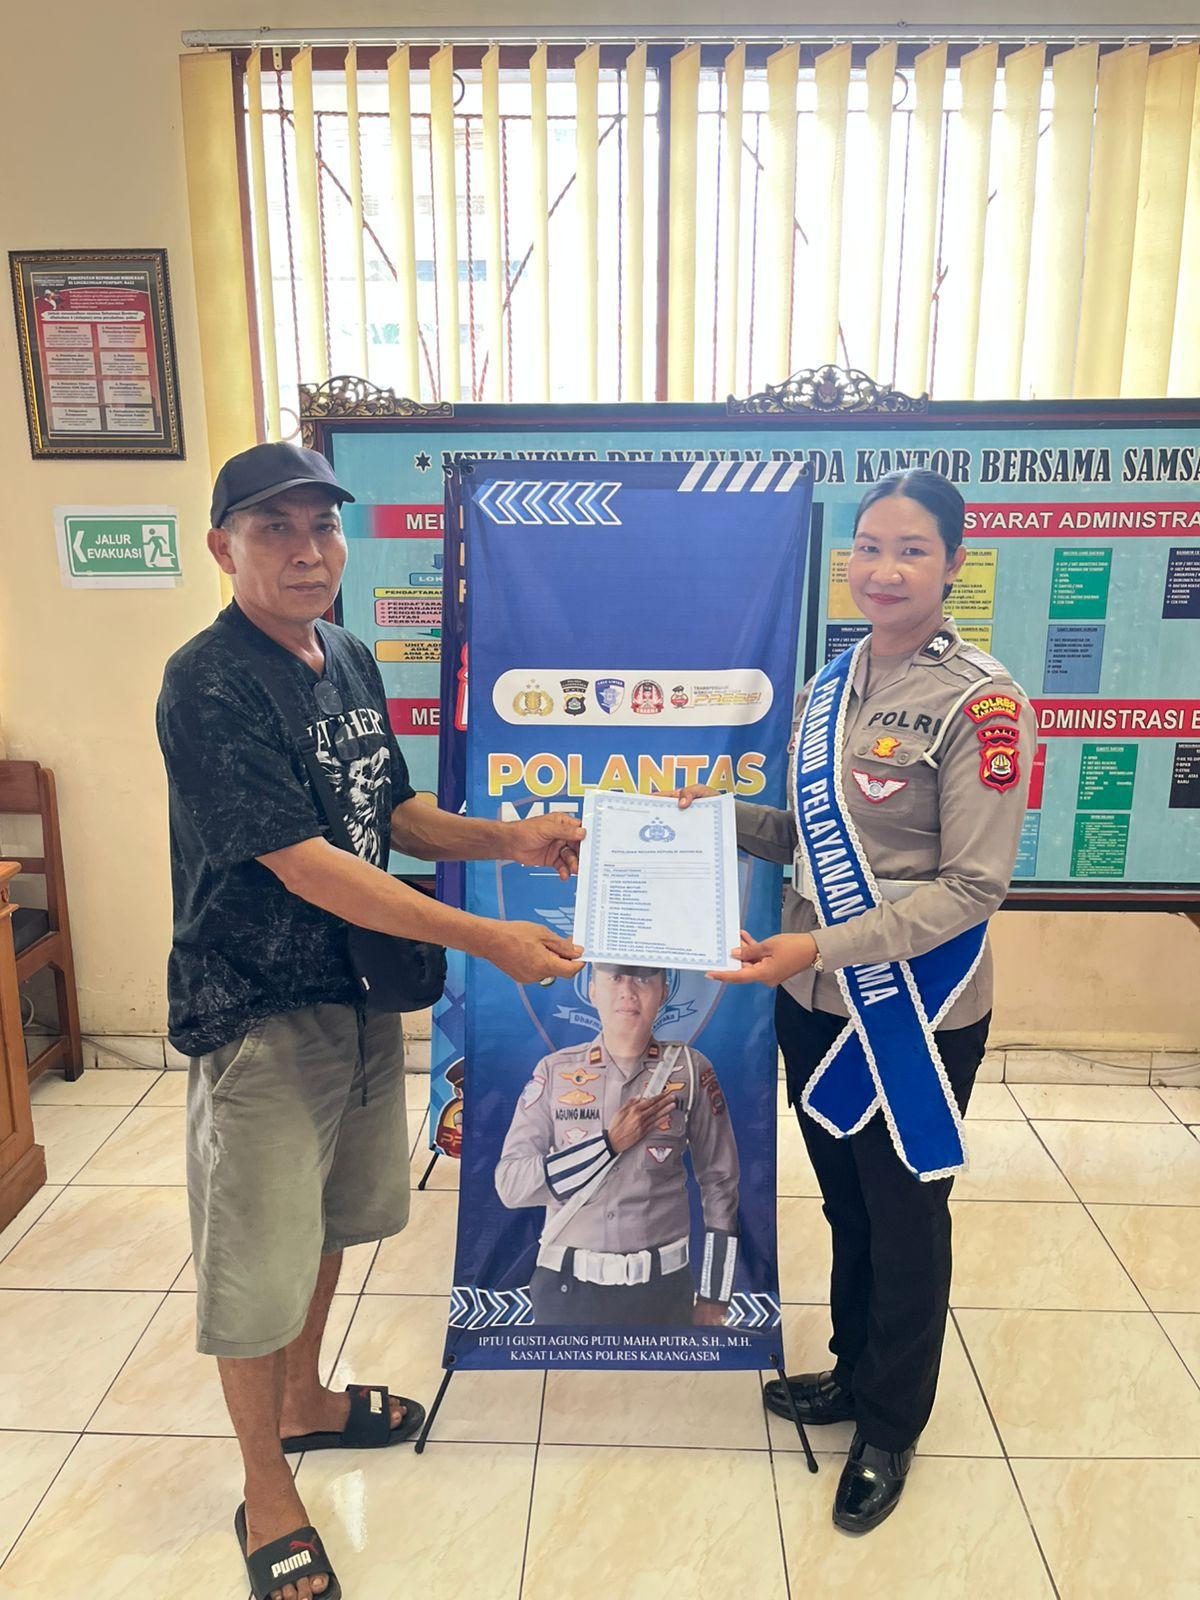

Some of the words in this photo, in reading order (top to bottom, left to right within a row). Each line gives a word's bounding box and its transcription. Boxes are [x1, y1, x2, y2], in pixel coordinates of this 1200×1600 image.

[980, 448, 1111, 483] BERSAMA
[95, 534, 131, 545] JALUR
[87, 548, 142, 559] EVAKUASI
[971, 697, 1016, 715] POLRES
[801, 677, 840, 775] PEMANDU
[868, 710, 944, 736] POLRI
[985, 728, 1013, 738] BALI
[487, 752, 767, 797] POLANTAS
[801, 778, 867, 921] PELAYANAN
[852, 961, 899, 1006] MA
[555, 1108, 579, 1120] AGUNG
[580, 1108, 600, 1120] MAHA
[479, 1336, 504, 1346] IPTU
[507, 1336, 510, 1346] I
[512, 1336, 546, 1346] GUSTI
[548, 1336, 589, 1346] AGUNG
[591, 1336, 620, 1346] PUTU
[623, 1336, 658, 1346] MAHA
[660, 1337, 699, 1347] PUTRA,
[702, 1337, 725, 1347] S.H.,
[727, 1337, 752, 1346] M.H.
[510, 1351, 546, 1360] KASAT
[550, 1351, 593, 1360] LANTAS
[596, 1351, 637, 1360] POLRES
[640, 1351, 720, 1361] KARANGASEM
[271, 1549, 312, 1578] PUMA
